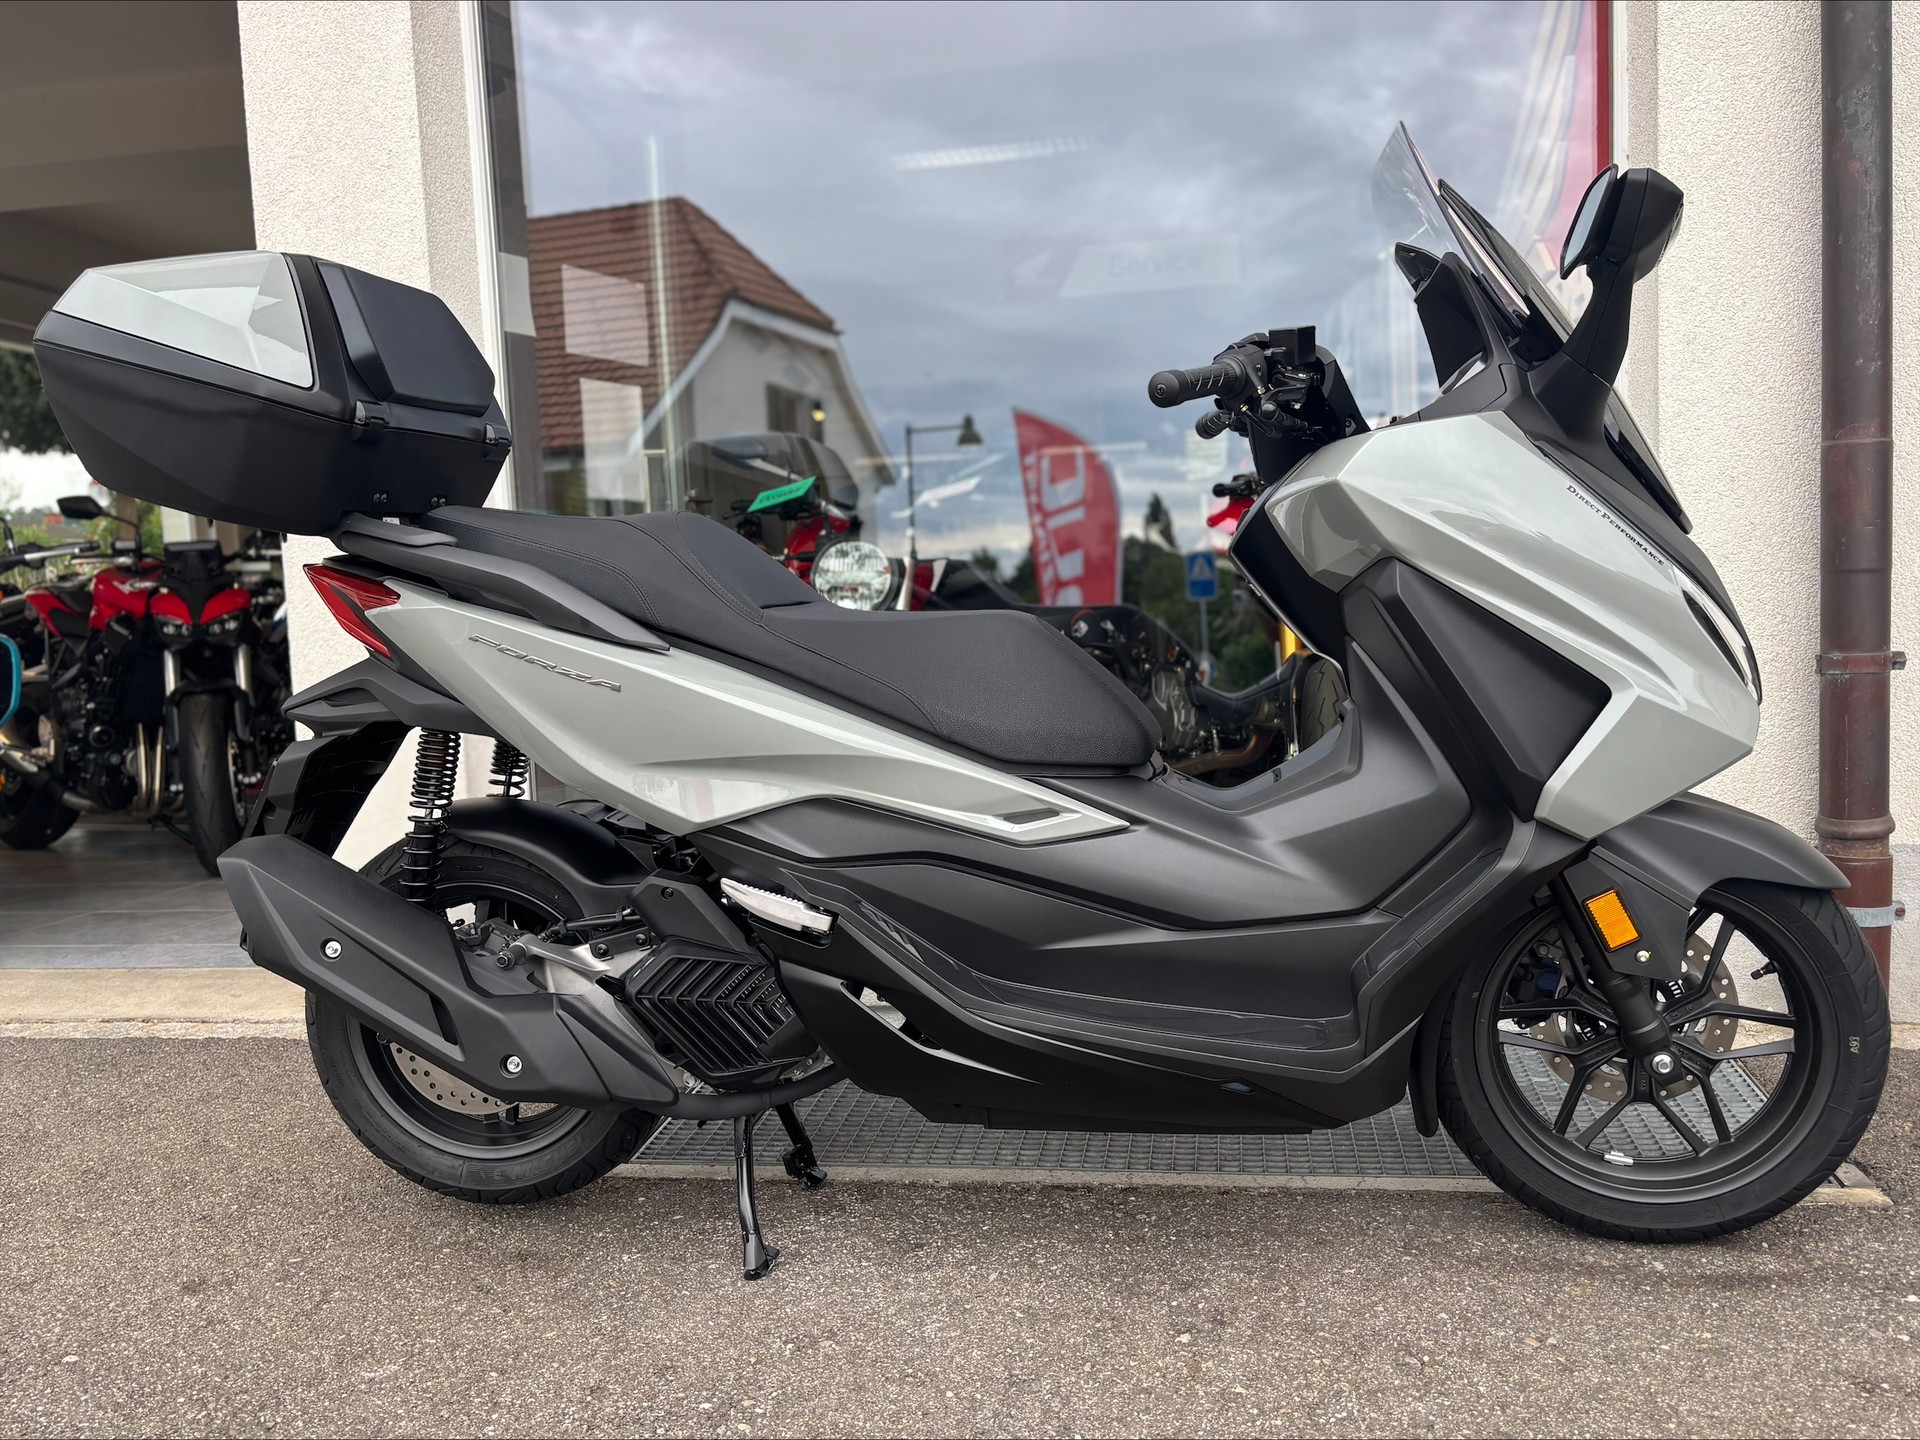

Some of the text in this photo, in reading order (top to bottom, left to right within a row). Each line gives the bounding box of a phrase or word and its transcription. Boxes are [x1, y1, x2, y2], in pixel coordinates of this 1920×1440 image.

[1107, 249, 1204, 278] Service
[1566, 484, 1665, 566] DIRECT PERFORMANCE
[468, 633, 622, 693] FORZA
